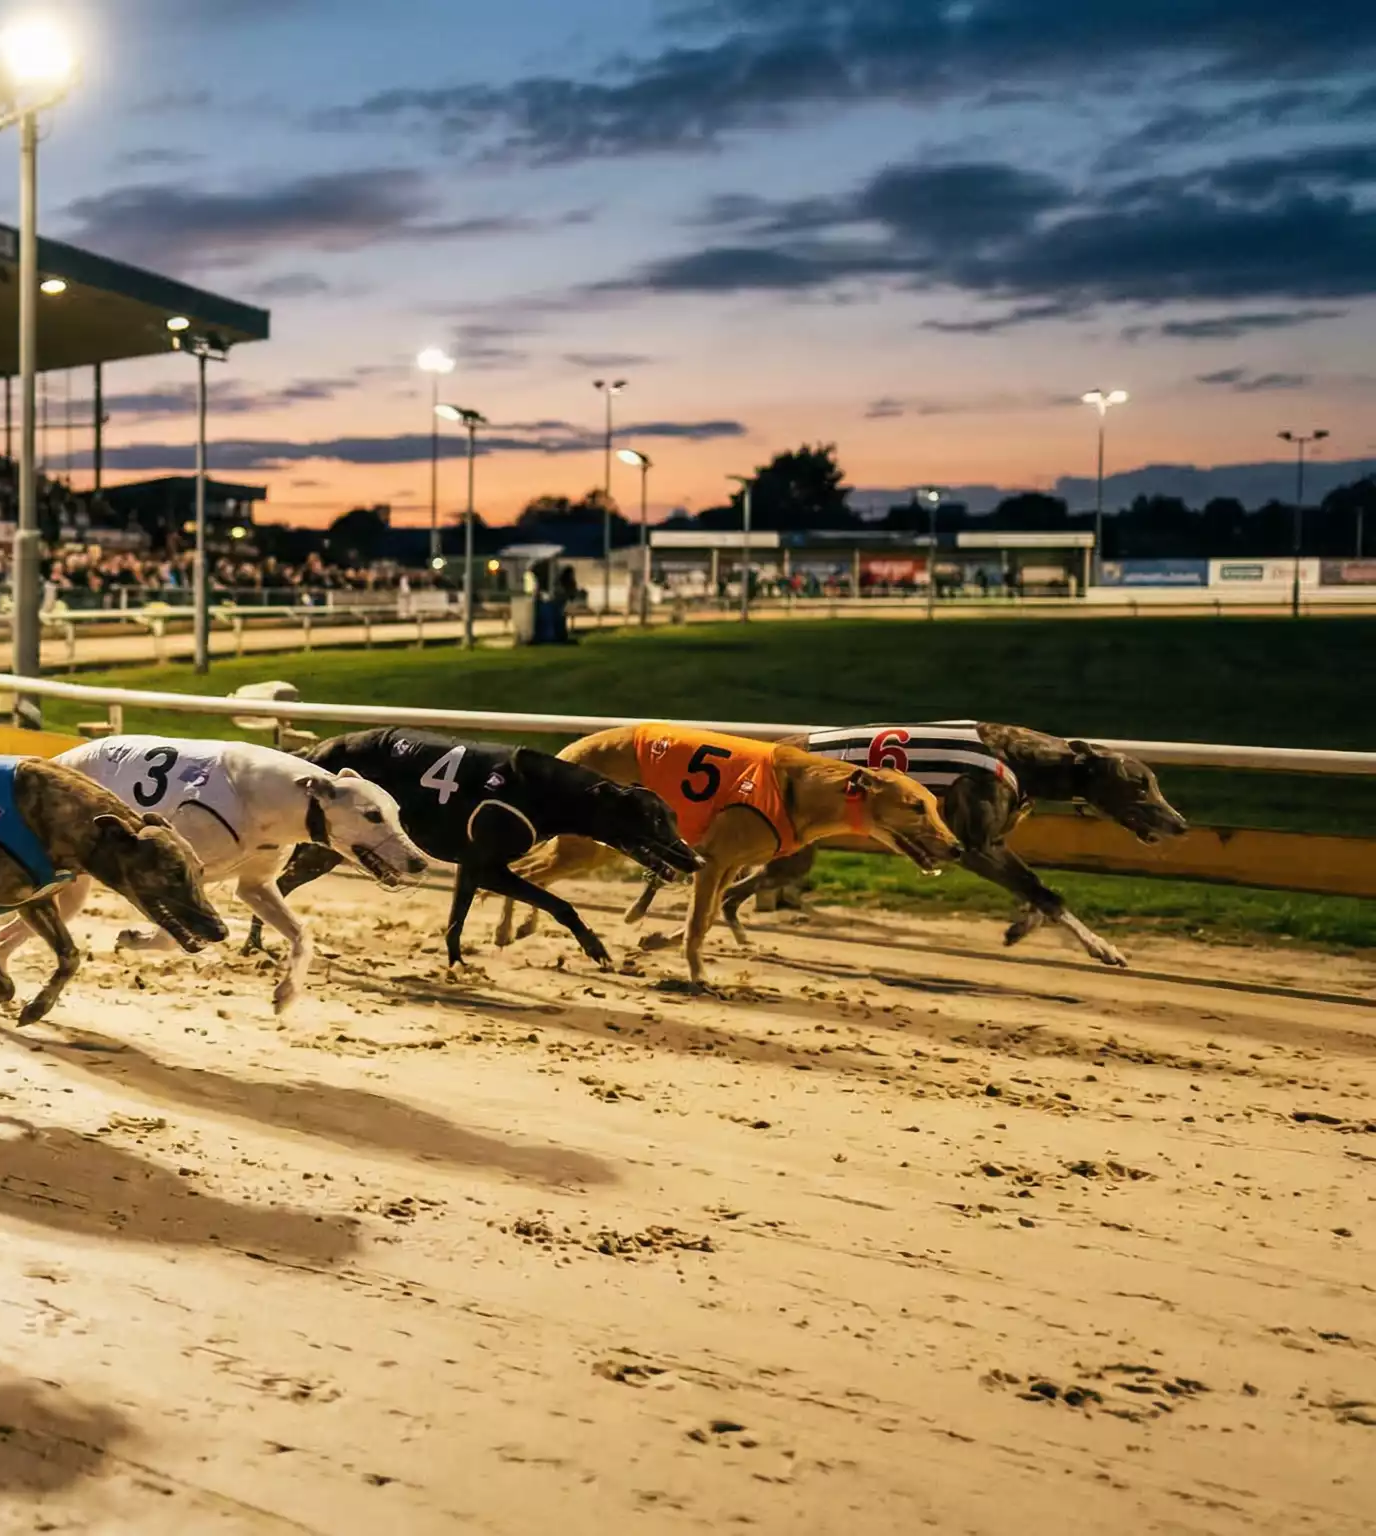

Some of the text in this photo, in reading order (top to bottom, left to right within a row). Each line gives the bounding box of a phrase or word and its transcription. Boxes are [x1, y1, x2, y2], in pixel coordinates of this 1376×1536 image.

[133, 746, 179, 807] 3
[420, 745, 467, 805] 4
[680, 743, 732, 803] 5
[866, 728, 911, 775] 6
